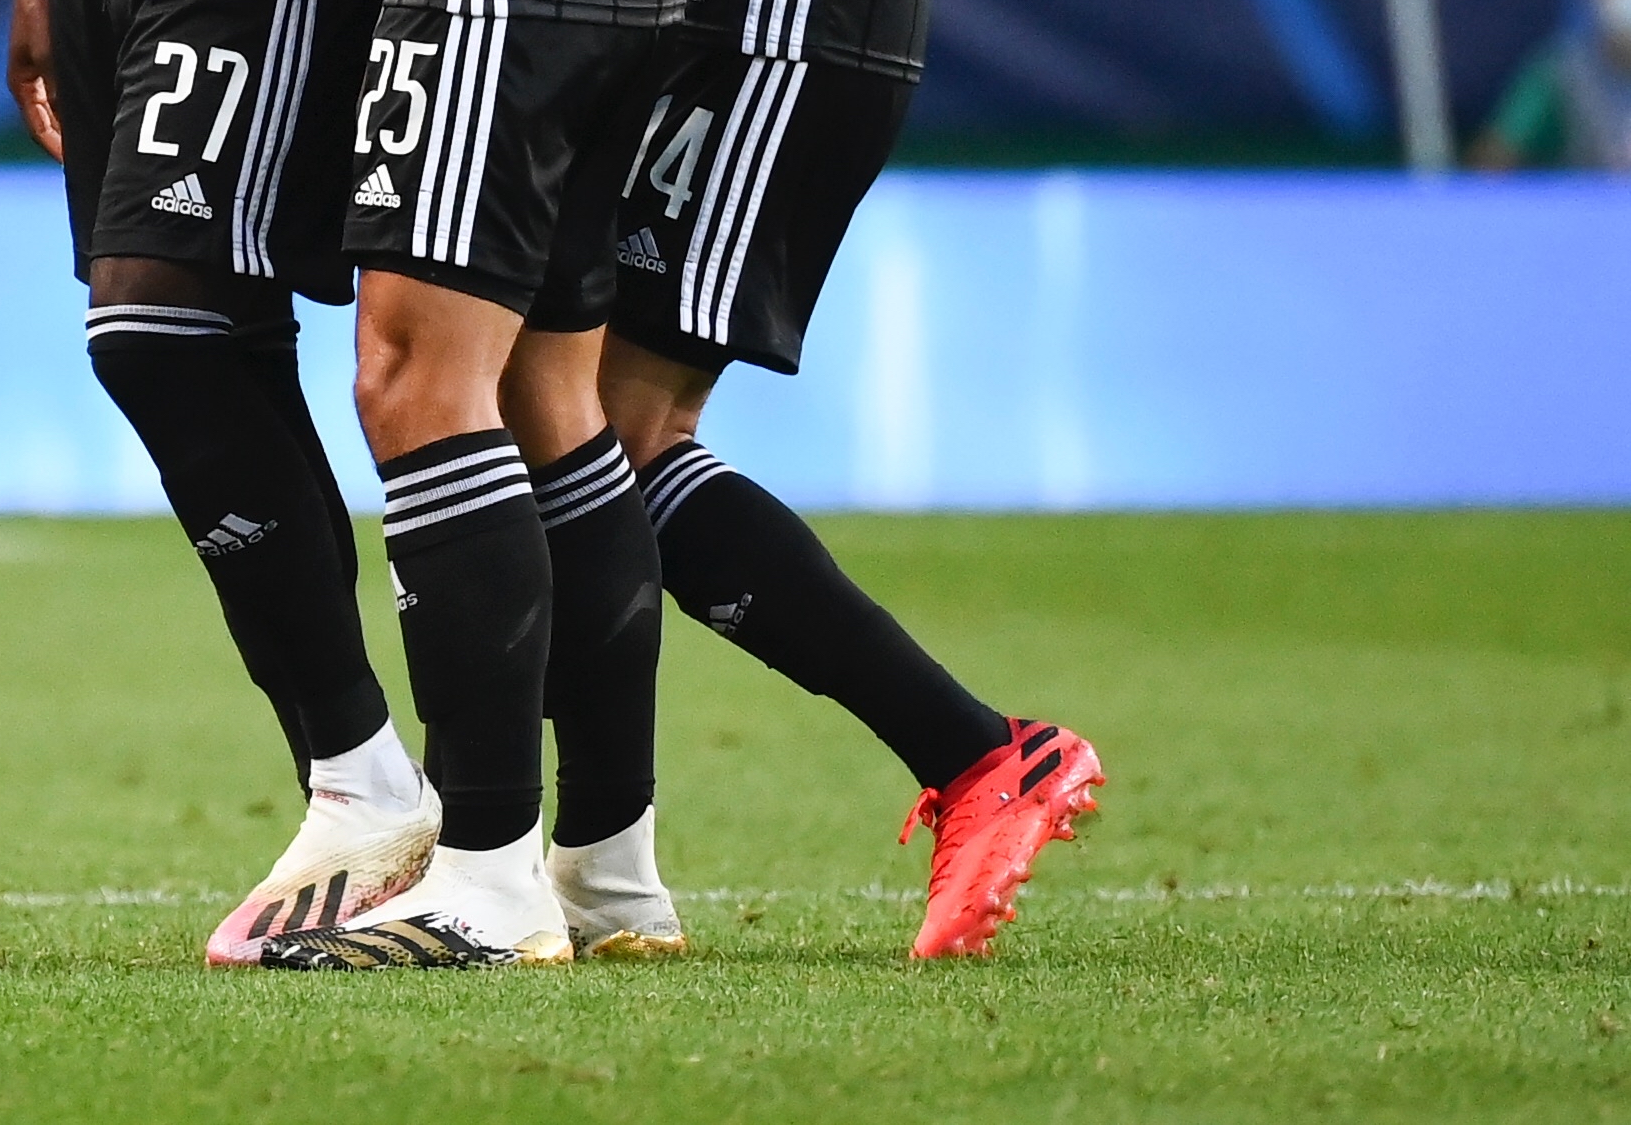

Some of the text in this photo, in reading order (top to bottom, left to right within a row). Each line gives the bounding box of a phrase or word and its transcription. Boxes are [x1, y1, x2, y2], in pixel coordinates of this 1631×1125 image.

[136, 40, 250, 163] 27
[353, 37, 439, 156] 25
[620, 93, 715, 221] 14
[151, 194, 213, 220] adidas
[354, 189, 401, 209] adidas
[616, 247, 667, 275] didas
